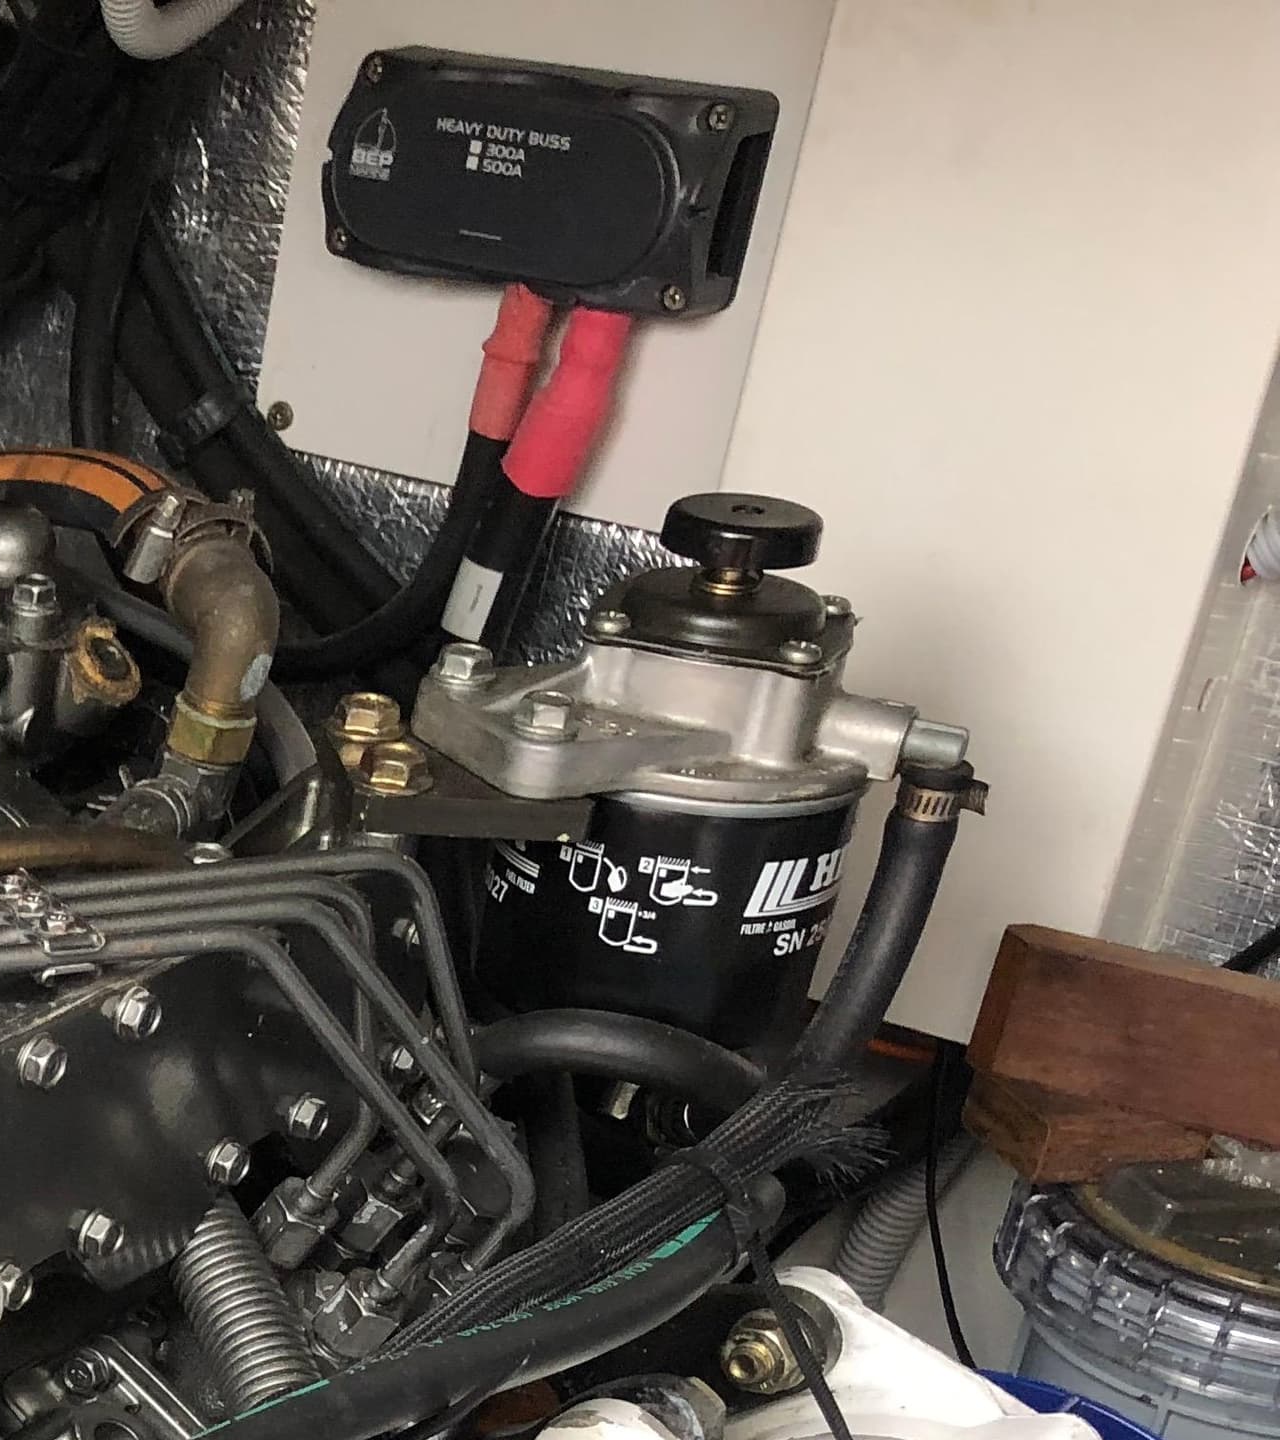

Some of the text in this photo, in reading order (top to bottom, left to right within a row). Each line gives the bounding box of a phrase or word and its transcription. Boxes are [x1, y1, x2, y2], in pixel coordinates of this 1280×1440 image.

[436, 117, 571, 151] HEAVY DUTY BUSS
[351, 148, 394, 167] BEP
[484, 143, 525, 162] 300A
[481, 158, 522, 177] 500A
[740, 922, 767, 935] FILTRE
[773, 928, 806, 956] SN
